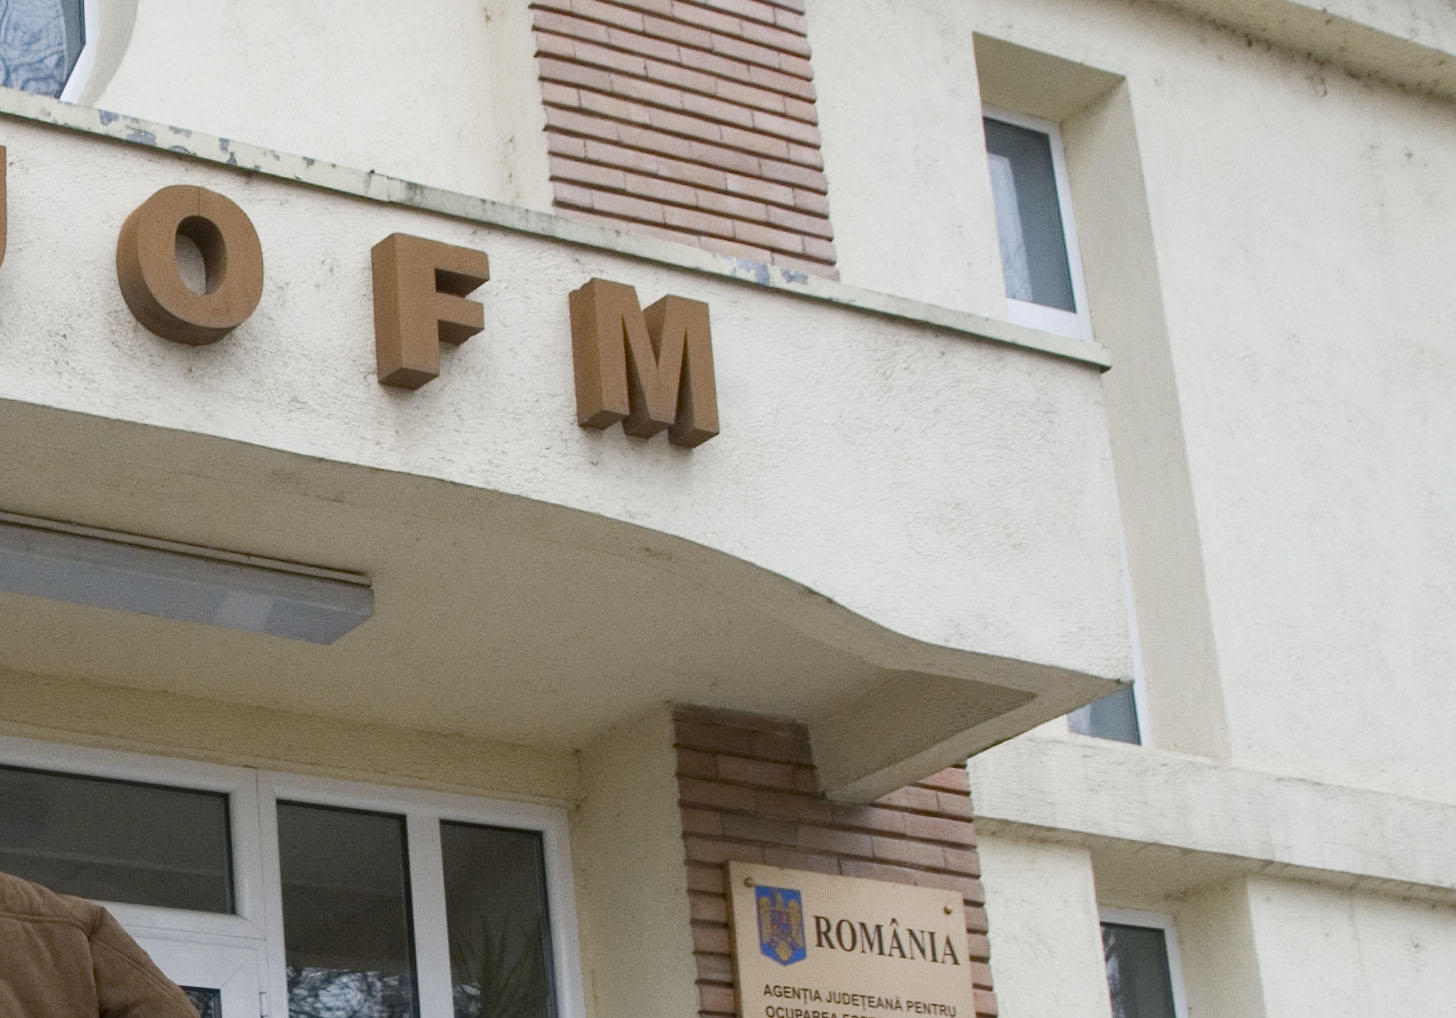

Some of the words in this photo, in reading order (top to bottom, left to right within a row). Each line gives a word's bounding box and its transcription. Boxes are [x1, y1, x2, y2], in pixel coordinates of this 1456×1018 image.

[813, 915, 960, 966] ROMÂNIA
[763, 984, 822, 1005] AGENȚIA
[906, 1000, 956, 1018] PENTRU
